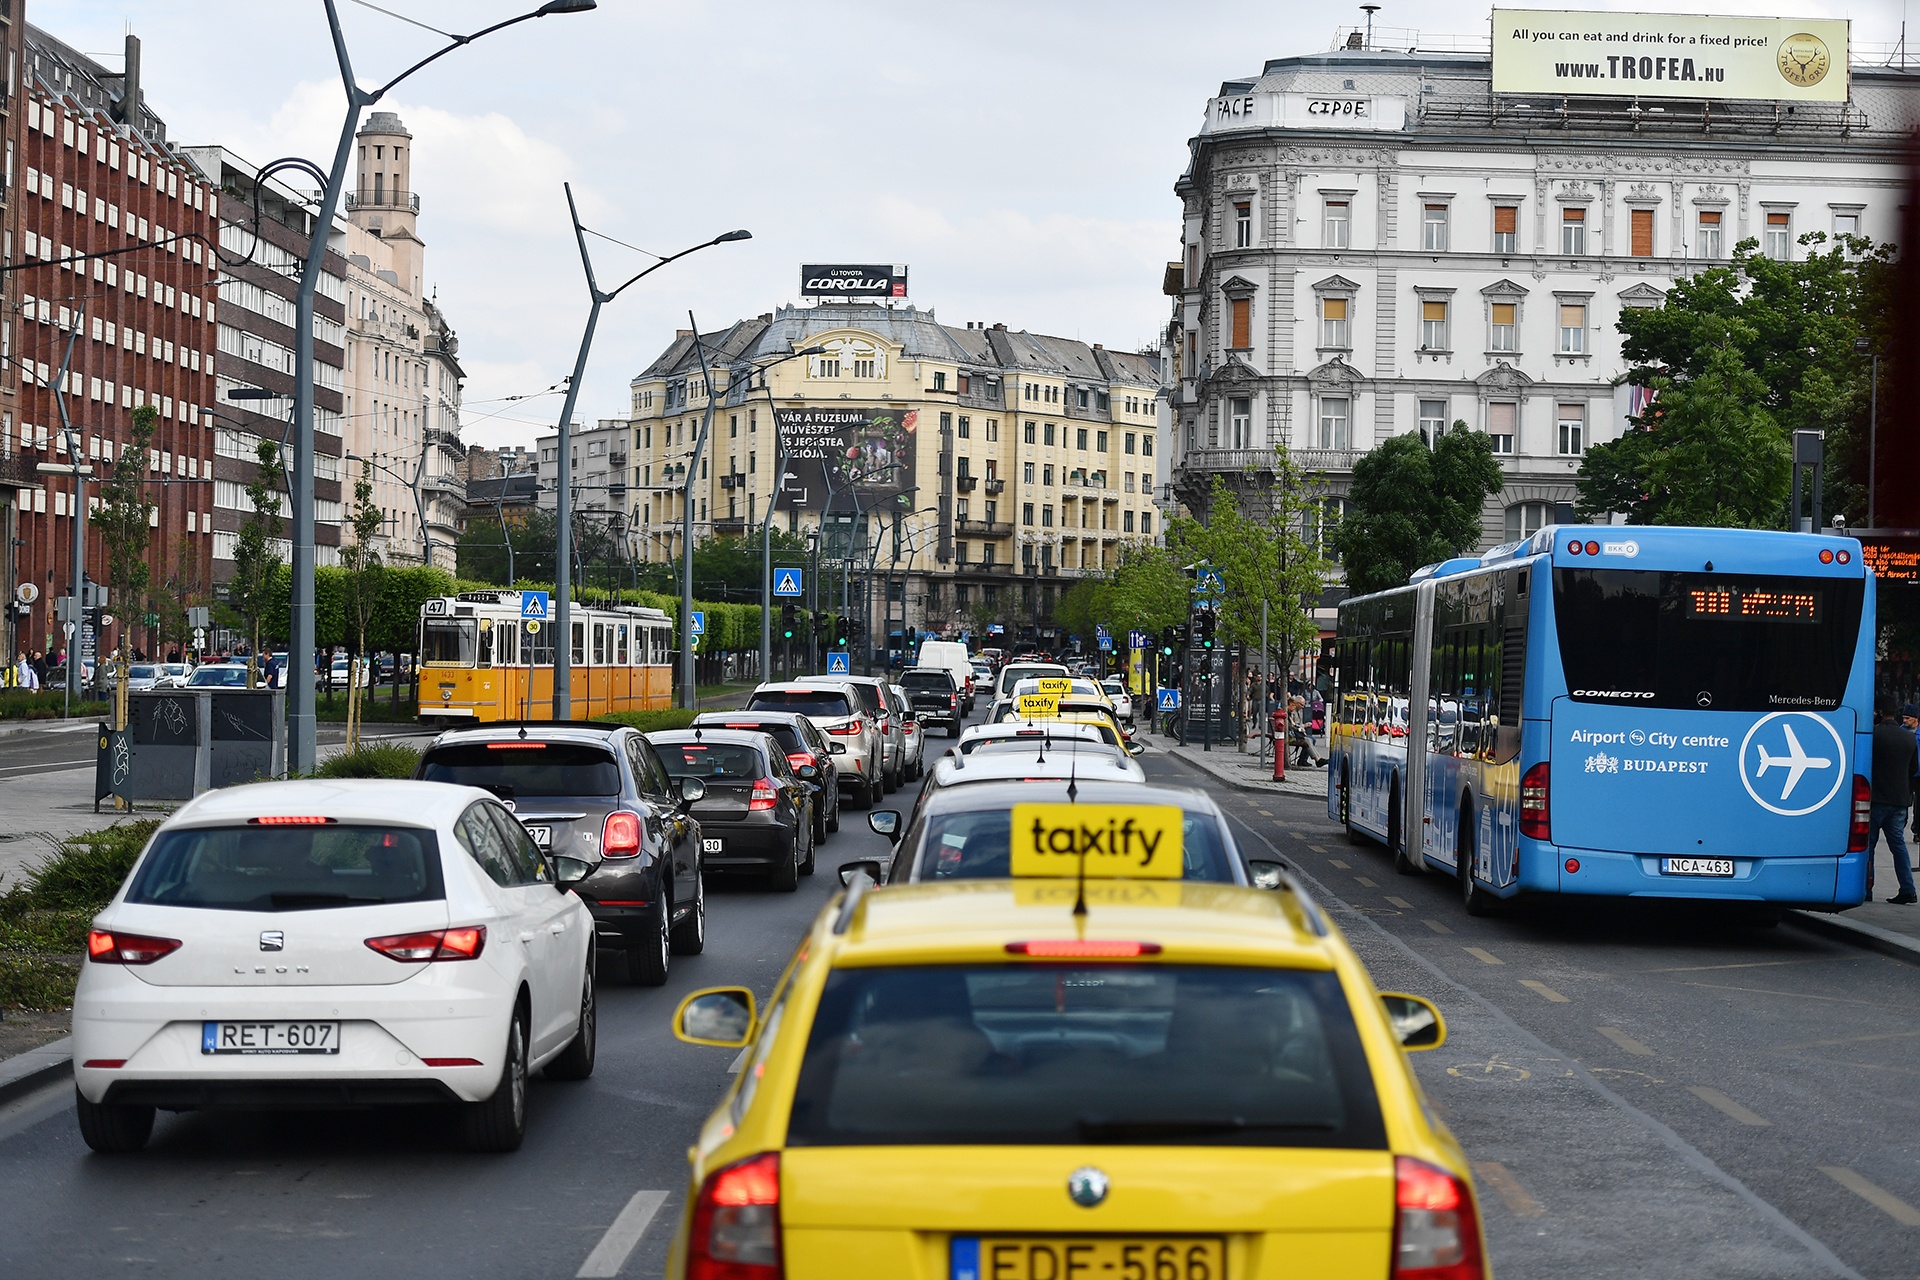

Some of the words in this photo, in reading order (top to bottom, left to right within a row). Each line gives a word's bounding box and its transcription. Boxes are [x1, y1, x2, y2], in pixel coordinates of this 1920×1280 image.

[1512, 29, 1529, 39] All
[1532, 32, 1555, 43] you
[1558, 32, 1580, 41] can
[1583, 31, 1603, 42] eat
[1605, 31, 1629, 42] and
[1632, 32, 1664, 43] drink
[1667, 33, 1686, 44] for
[1688, 36, 1696, 45] a
[1699, 33, 1730, 46] fixed
[1734, 36, 1768, 49] price!
[1217, 97, 1254, 121] FACE
[830, 268, 839, 277] ÚJ
[806, 278, 888, 291] COROLLA
[780, 411, 802, 423] VÁR
[804, 413, 812, 423] A
[1912, 571, 1917, 579] 2
[428, 602, 443, 613] 47
[441, 671, 455, 679] 1433
[1042, 681, 1068, 691] taxify
[1572, 689, 1656, 699] CONECTO
[1023, 698, 1054, 710] taxify
[1768, 694, 1837, 707] Mercedes-Benz
[1570, 729, 1626, 747] Airport
[1649, 732, 1678, 750] City
[1681, 734, 1729, 748] centre
[1623, 759, 1709, 774] BUDAPEST
[705, 840, 720, 851] 30
[1032, 817, 1164, 867] taxify
[1671, 859, 1731, 874] NCA-463
[234, 965, 309, 975] LEON
[207, 1038, 214, 1047] H
[222, 1024, 332, 1047] RET-607
